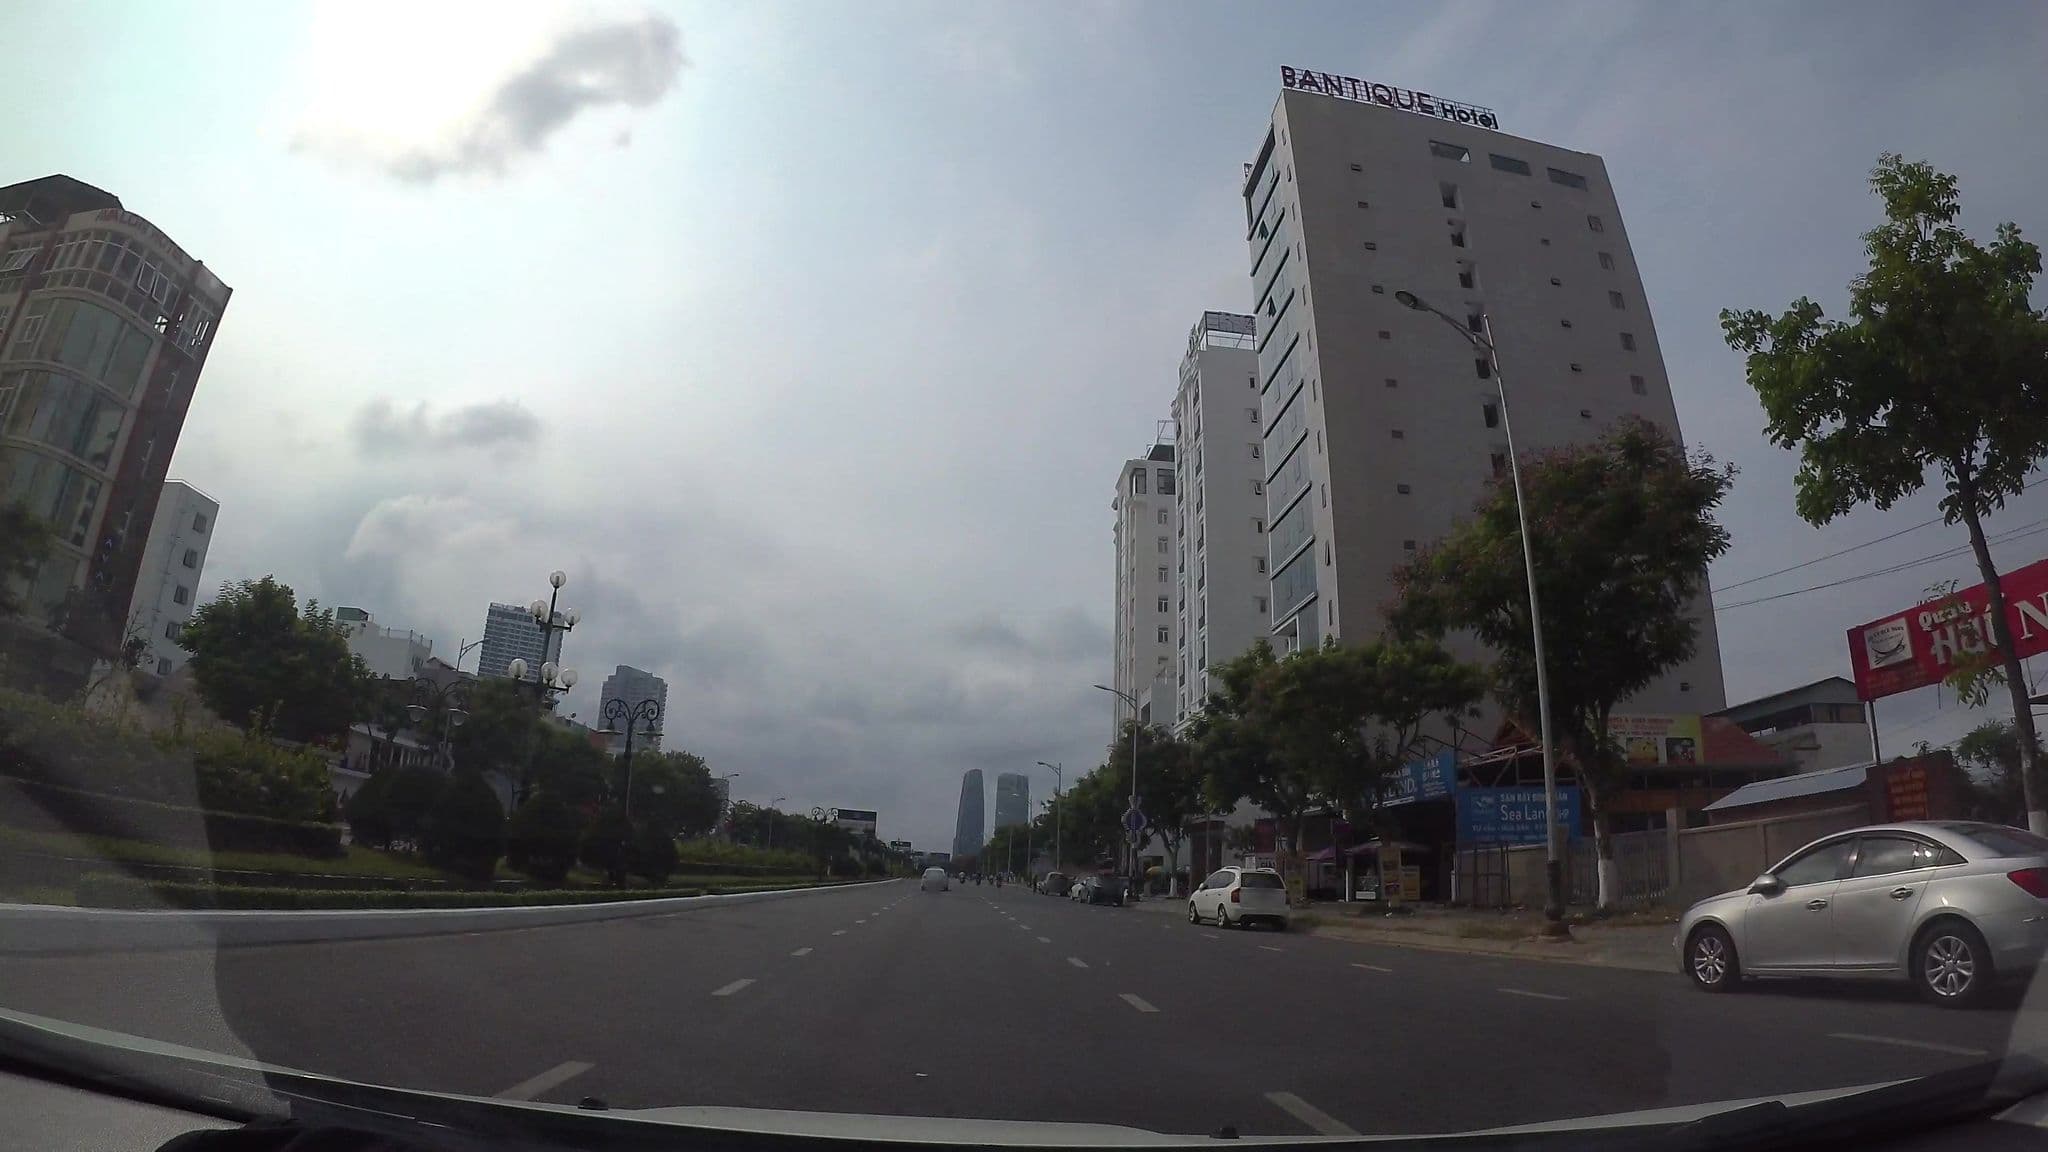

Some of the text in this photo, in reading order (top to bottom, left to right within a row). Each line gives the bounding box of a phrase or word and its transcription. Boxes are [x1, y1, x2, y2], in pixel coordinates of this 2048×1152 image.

[1281, 65, 1499, 129] BANTIQUE Hotel
[1500, 804, 1522, 821] Sea
[1525, 804, 1547, 821] Lan
